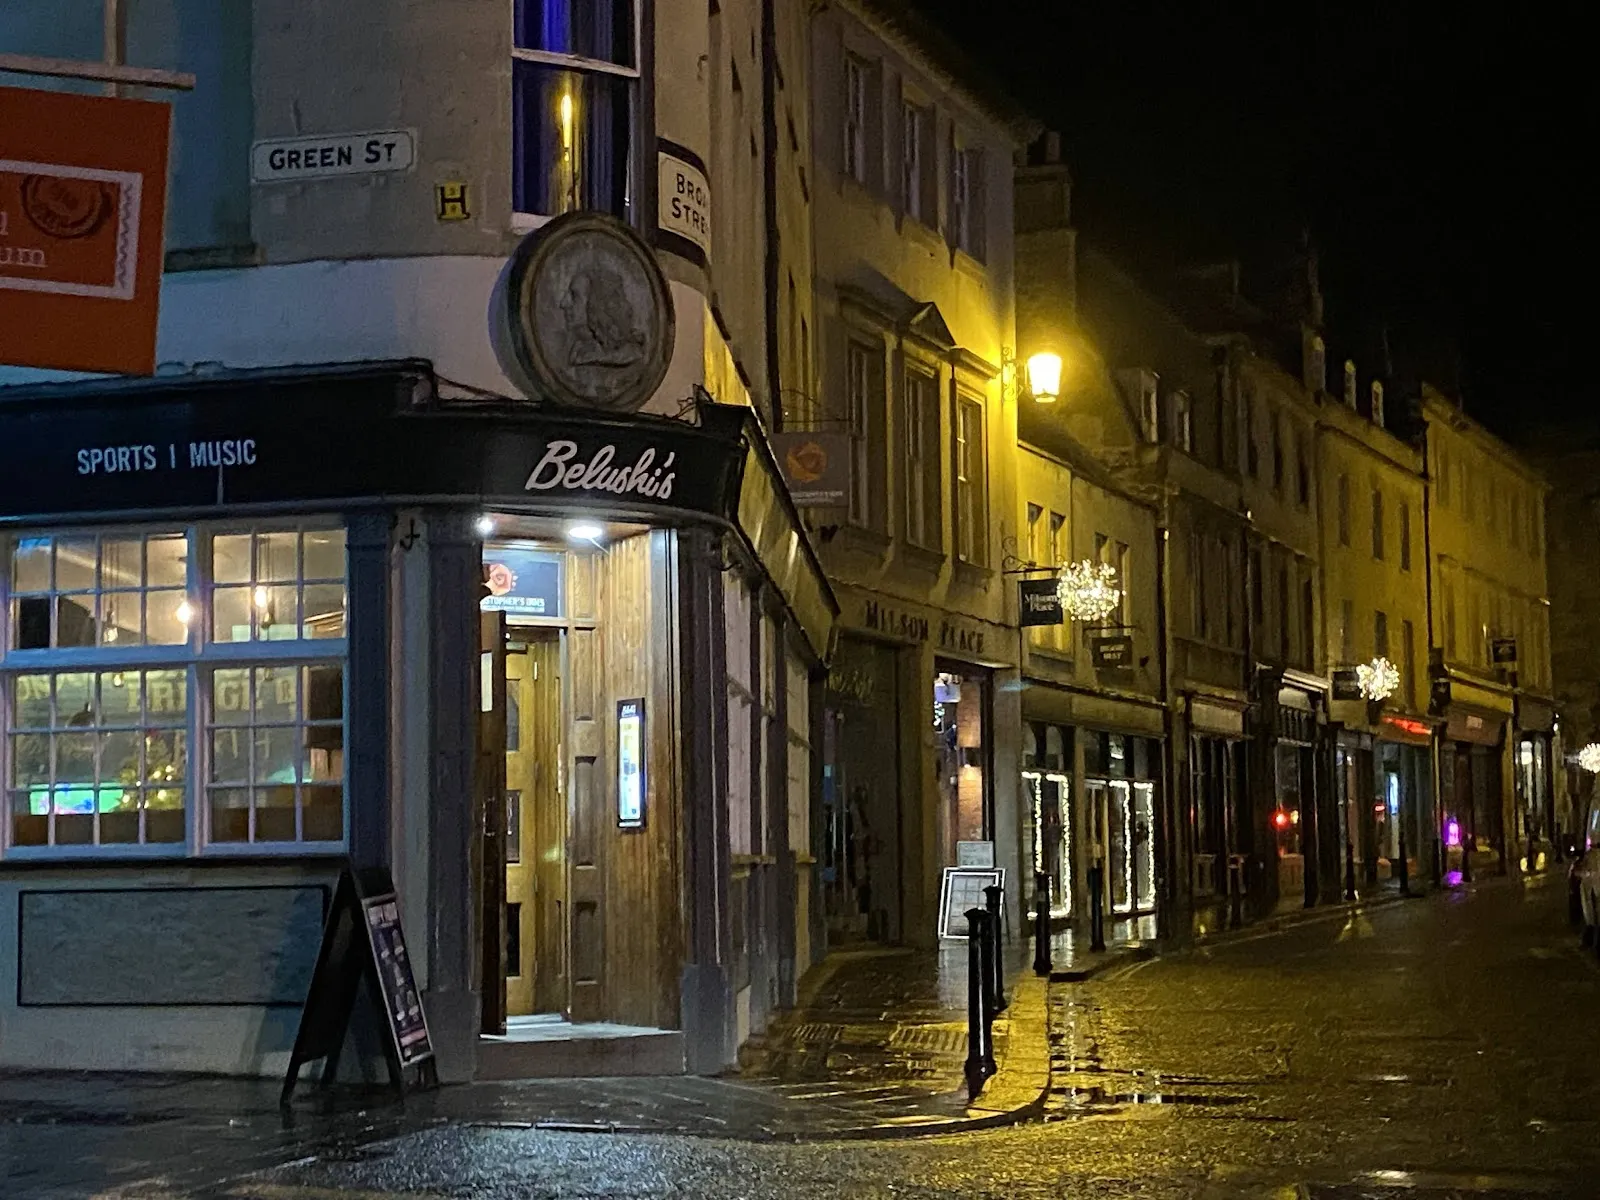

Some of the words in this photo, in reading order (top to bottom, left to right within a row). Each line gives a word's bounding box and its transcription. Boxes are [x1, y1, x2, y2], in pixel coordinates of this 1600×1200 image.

[269, 147, 352, 170] GREEN
[77, 444, 156, 475] SPORTS
[189, 439, 256, 468] MUSIC
[525, 439, 676, 499] Belushi's
